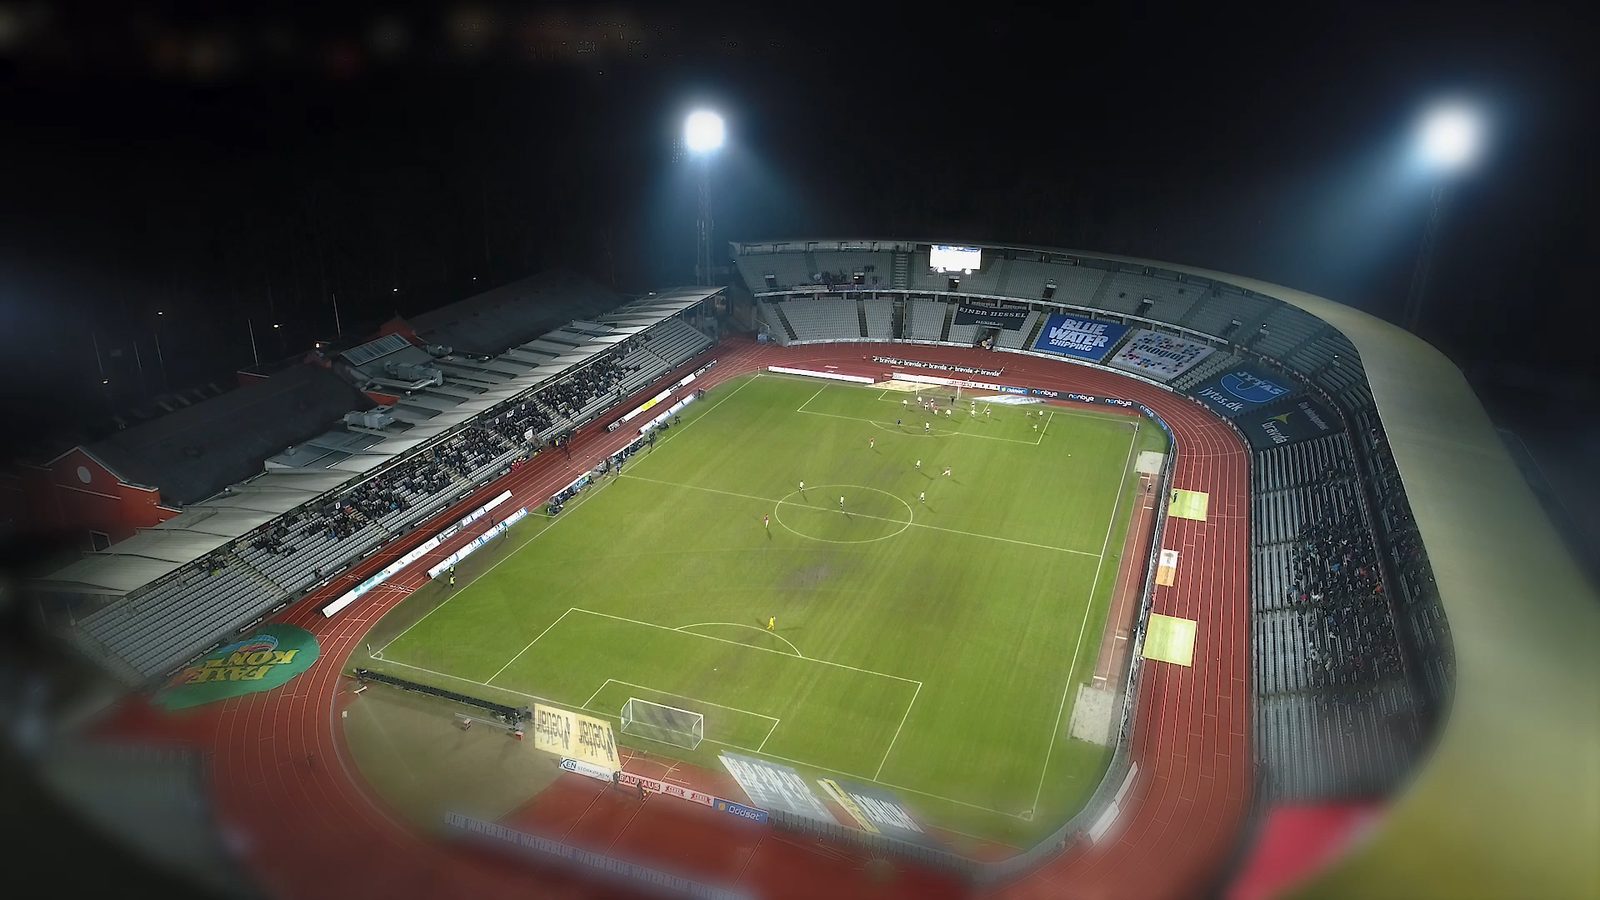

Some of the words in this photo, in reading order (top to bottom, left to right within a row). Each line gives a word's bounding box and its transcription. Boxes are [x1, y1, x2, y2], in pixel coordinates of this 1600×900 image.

[959, 306, 988, 316] EJNER
[989, 310, 1027, 319] HESSEL
[1061, 318, 1108, 335] BLUE
[1048, 326, 1109, 348] WATER
[1049, 338, 1093, 352] SHIPPING
[1236, 371, 1284, 395] JYTAS
[1199, 386, 1243, 412] jytas.dk
[560, 757, 577, 771] KEN
[728, 805, 761, 821] Oddset
